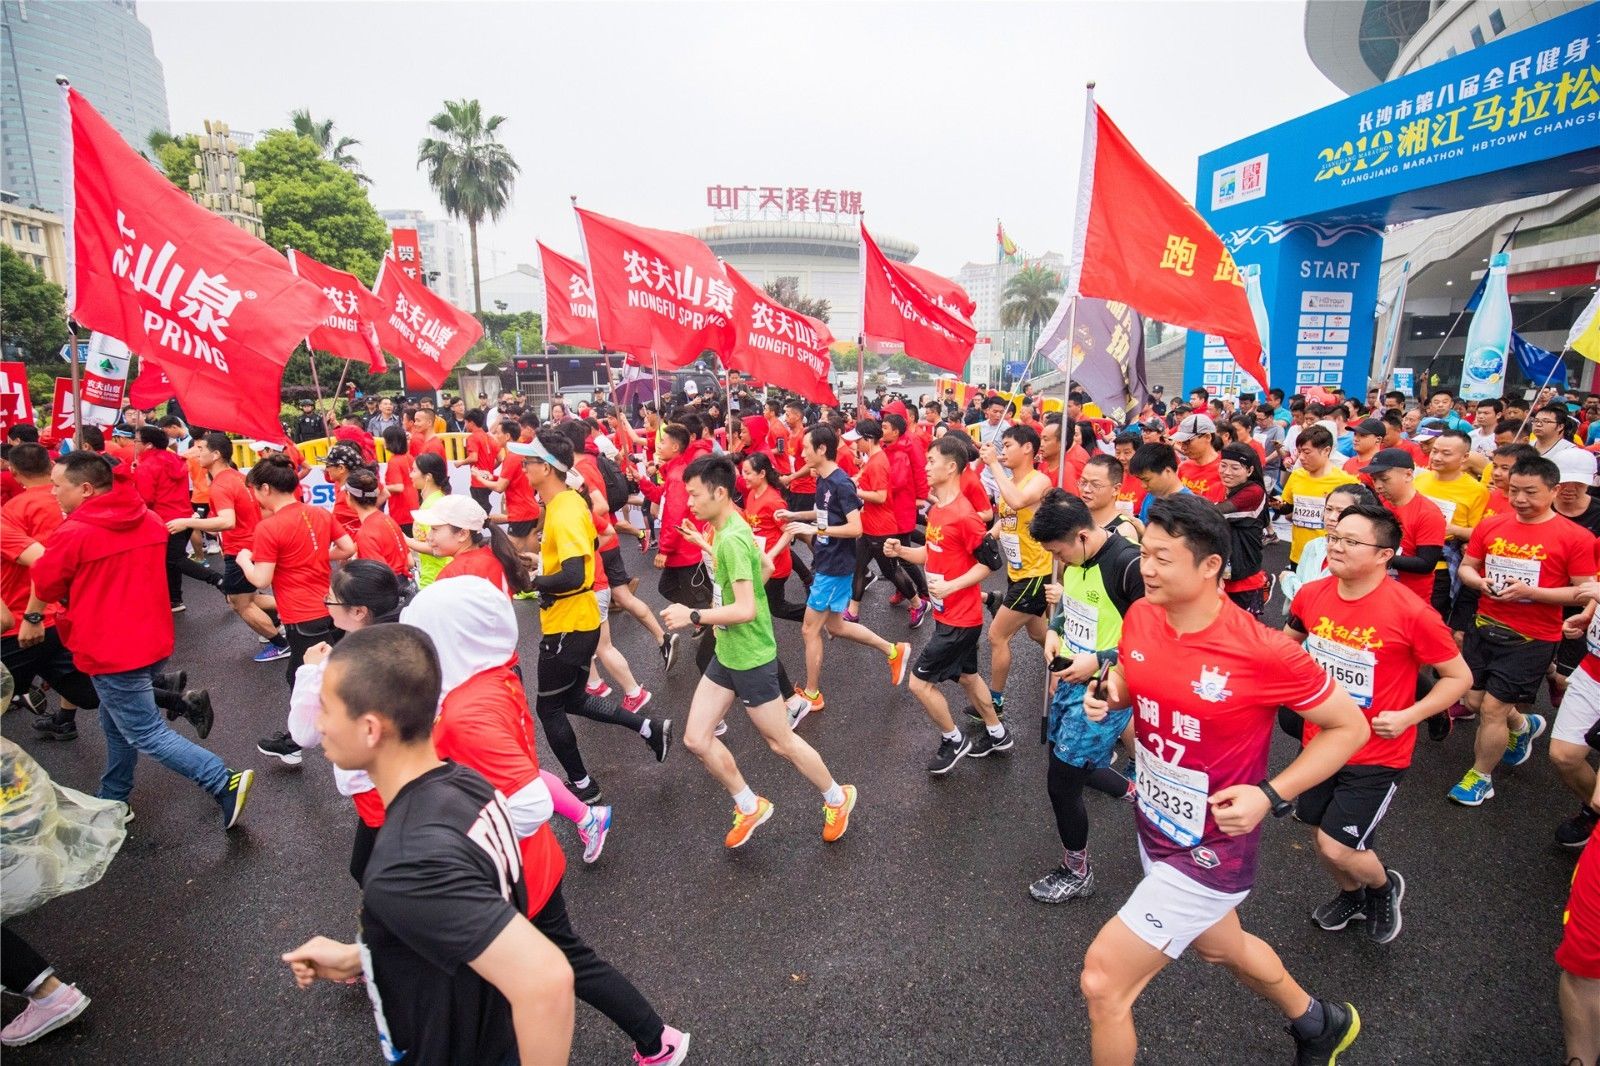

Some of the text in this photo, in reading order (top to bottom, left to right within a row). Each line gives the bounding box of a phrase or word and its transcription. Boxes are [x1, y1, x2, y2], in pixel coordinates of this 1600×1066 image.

[1358, 33, 1600, 133] 长沙市第八届全民健身
[1340, 111, 1600, 187] XIANGJIANG MARATHON HBTOWN CHANGS
[706, 184, 863, 215] 中广天择传媒
[623, 249, 738, 320] 农夫山泉
[1299, 259, 1361, 280] START
[395, 291, 457, 350] 农夫山泉
[628, 289, 676, 321] NONGFU
[138, 304, 230, 374] PRING
[748, 331, 795, 358] NONGFU
[1293, 506, 1321, 519] A12284
[1148, 732, 1186, 770] 37
[1138, 770, 1194, 820] A12333
